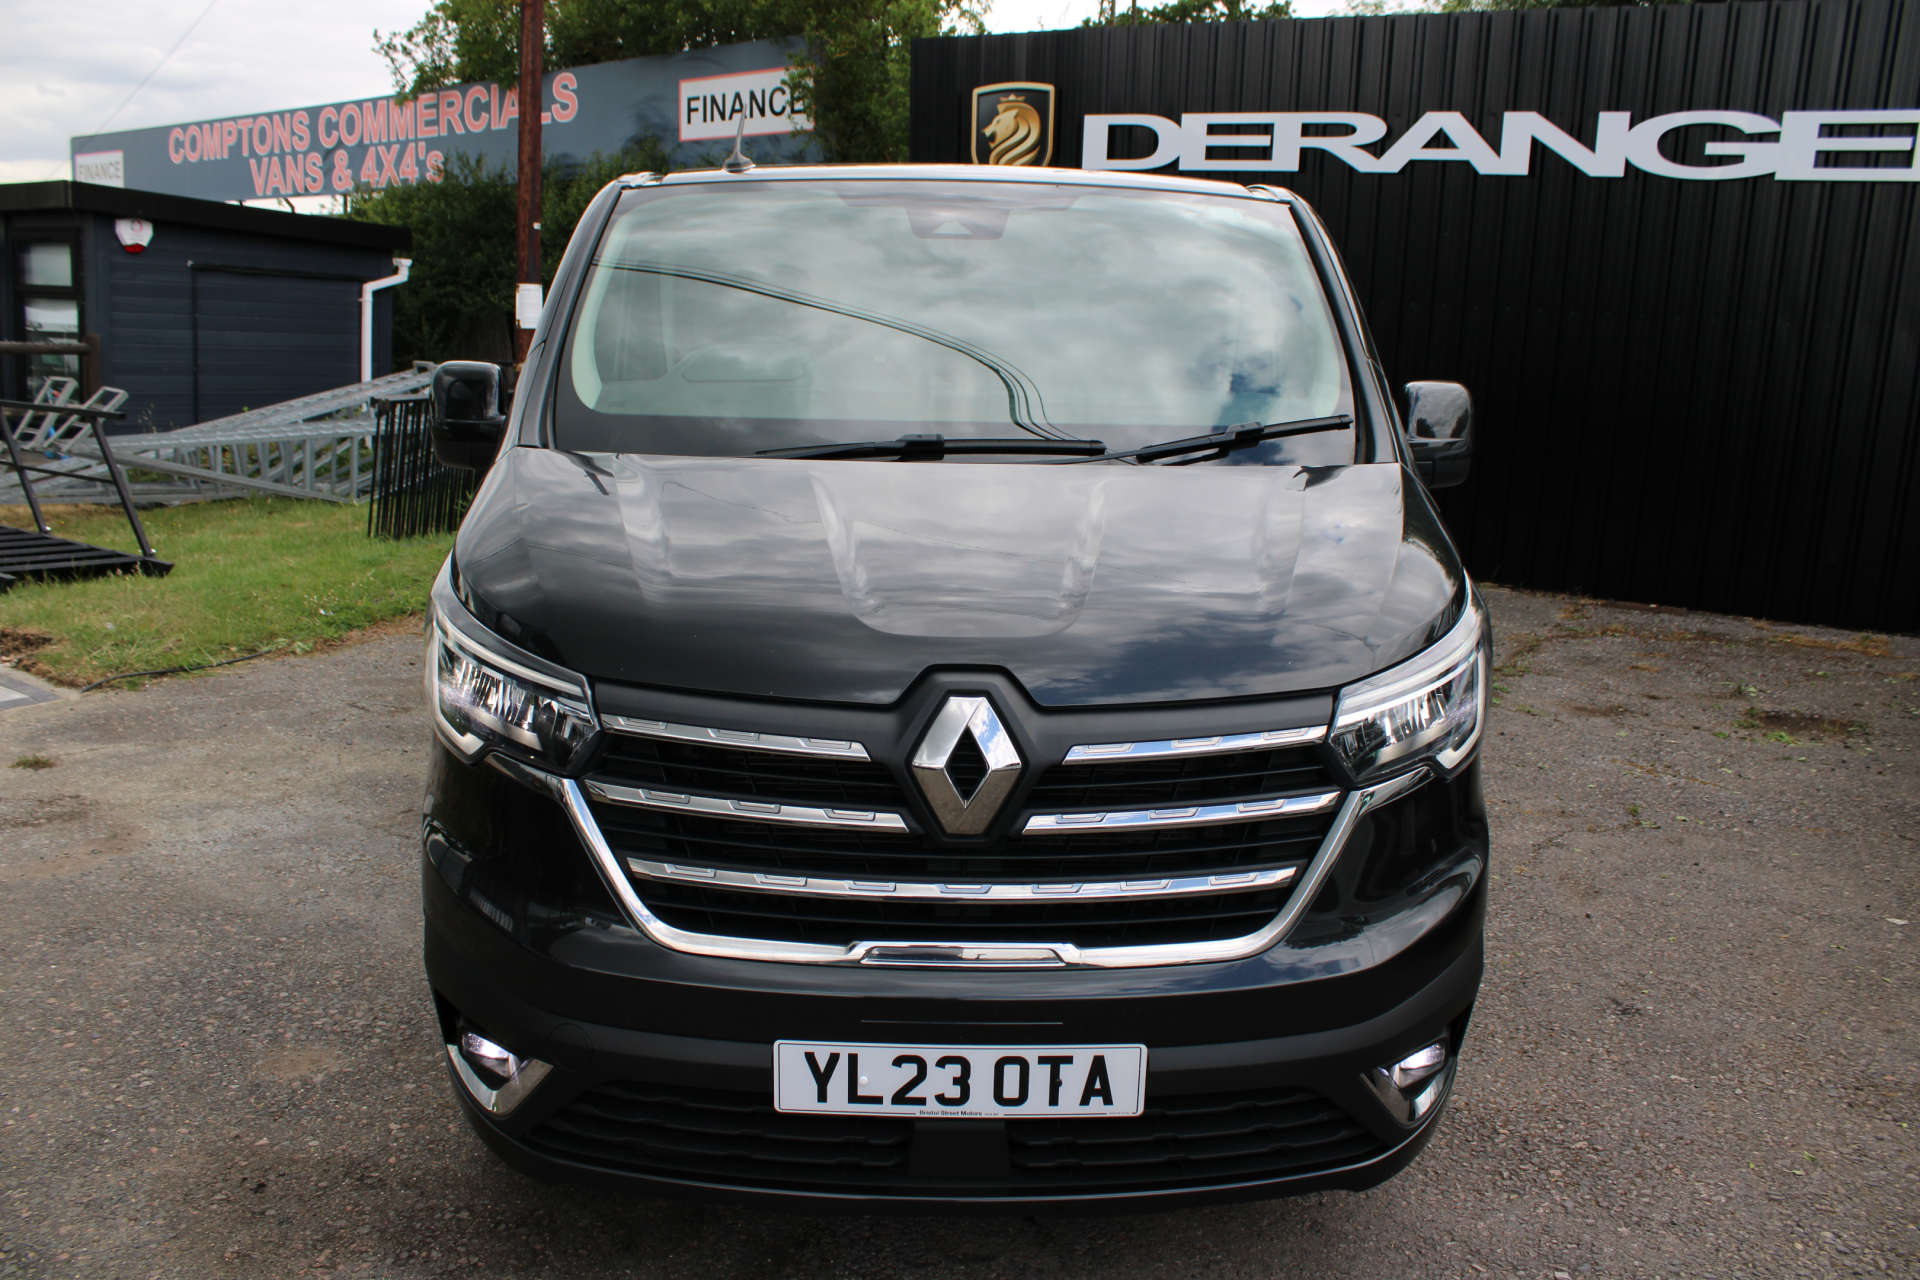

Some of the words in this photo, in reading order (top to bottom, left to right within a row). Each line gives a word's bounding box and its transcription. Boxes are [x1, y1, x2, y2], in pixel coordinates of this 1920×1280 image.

[168, 110, 311, 165] COMPTONS
[318, 71, 579, 149] COMMERCIAS
[686, 86, 810, 125] FINANCE
[79, 160, 122, 181] FINANCE
[250, 152, 324, 196] VANS
[332, 149, 354, 191] &
[361, 140, 445, 188] 4X4's
[1081, 110, 1920, 182] DERANGE
[803, 1051, 972, 1108] YL23
[993, 1054, 1115, 1108] OTA
[919, 1109, 939, 1117] Bristol
[940, 1109, 960, 1117] Street
[961, 1109, 983, 1117] Motors
